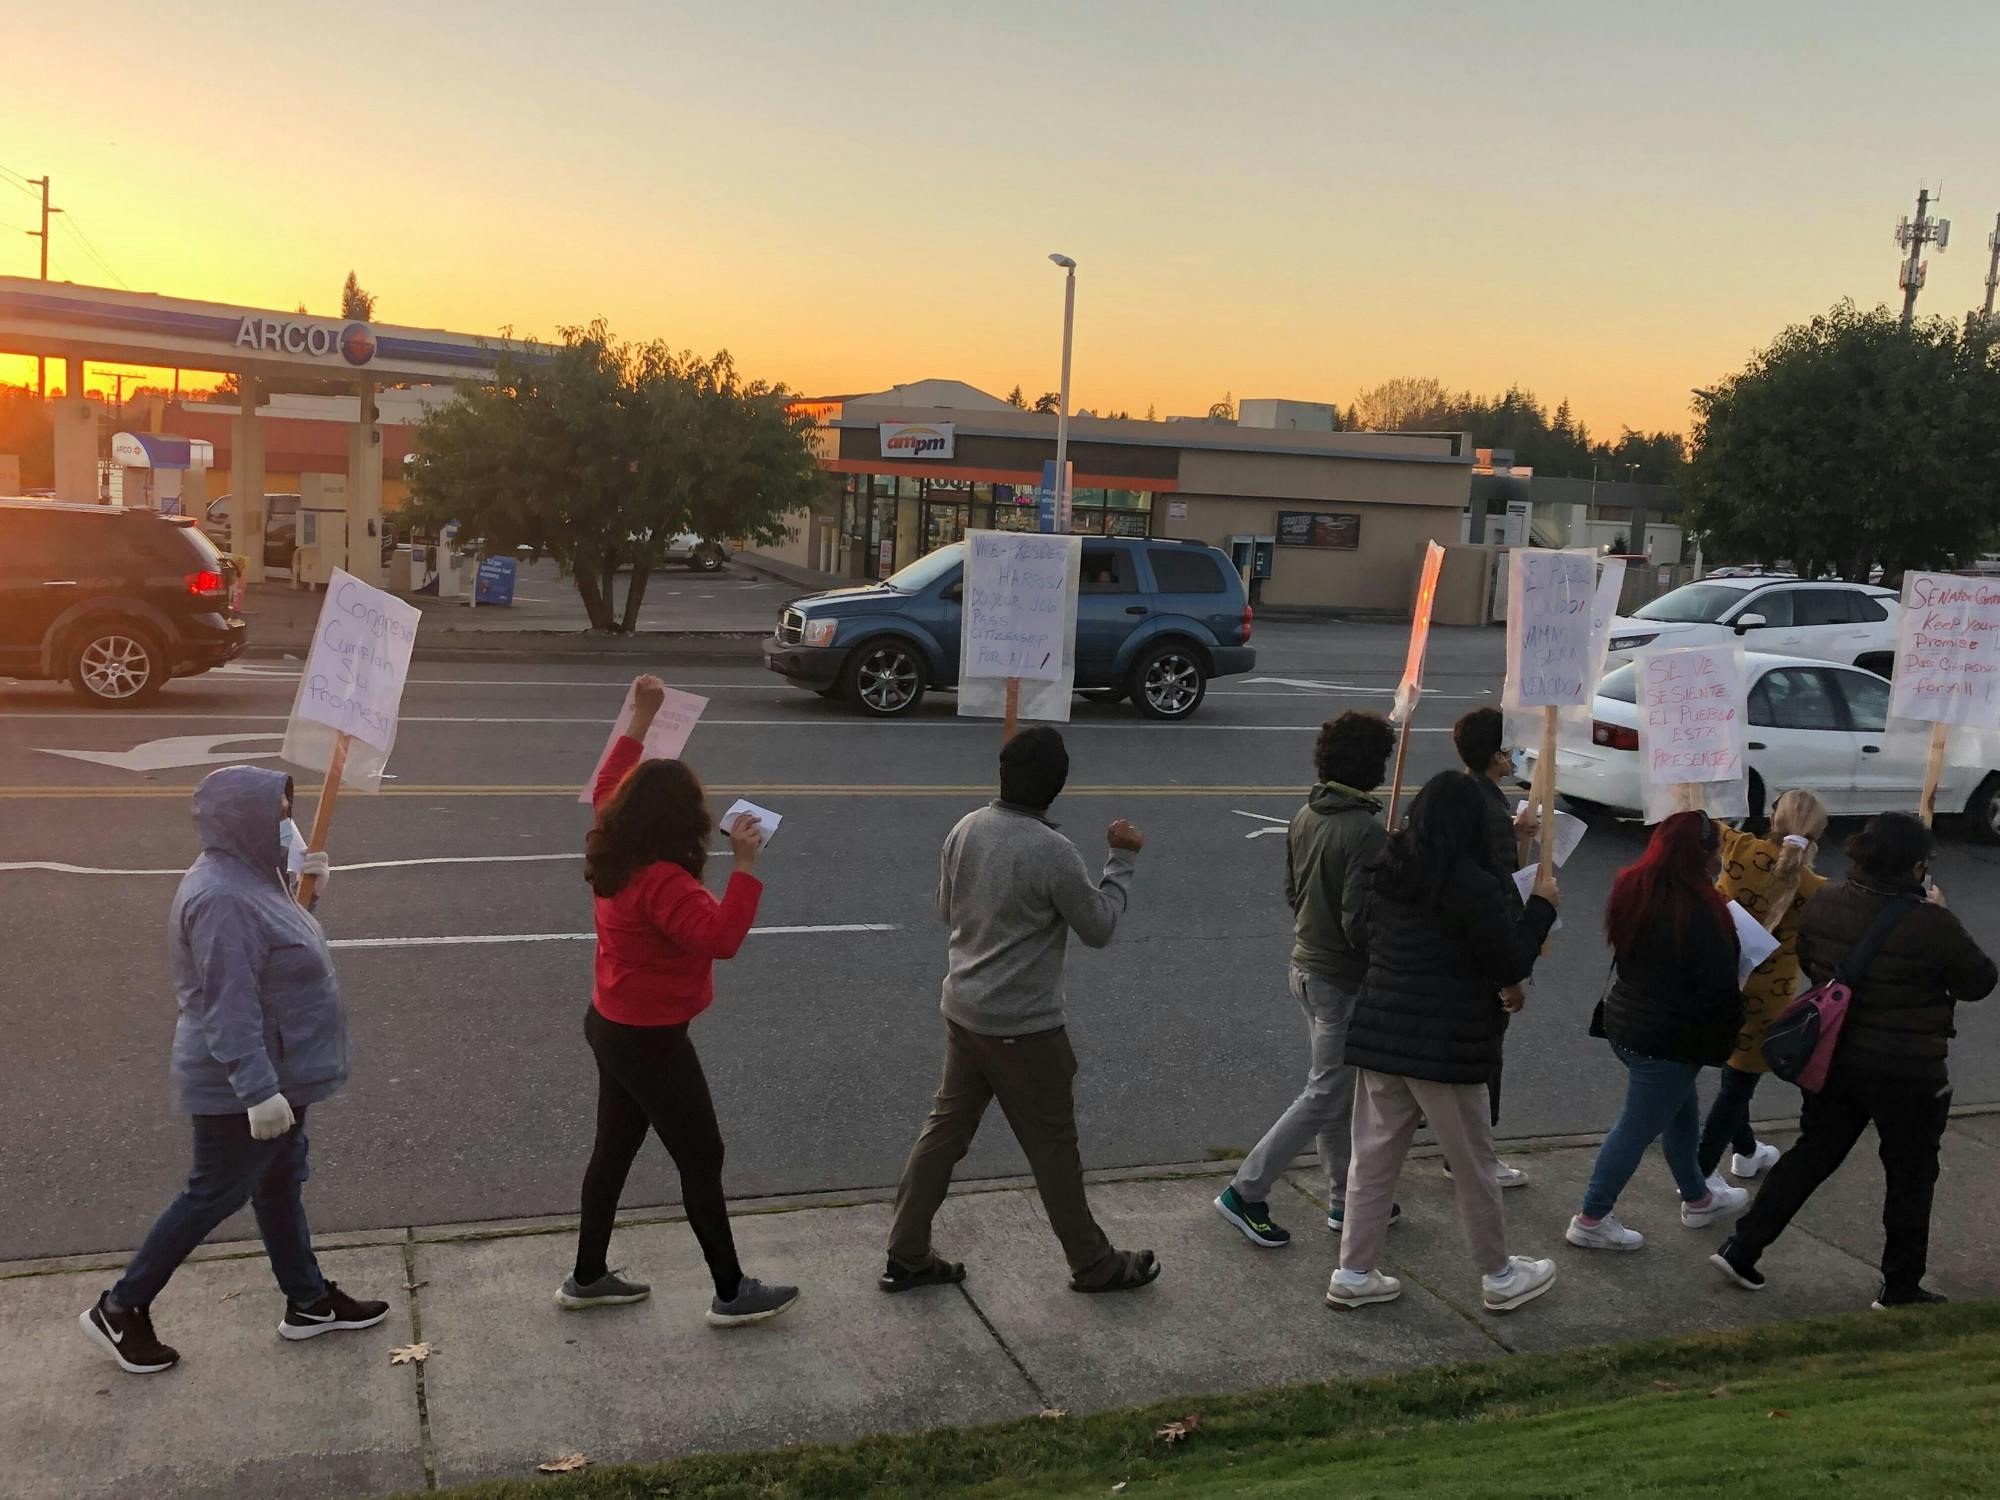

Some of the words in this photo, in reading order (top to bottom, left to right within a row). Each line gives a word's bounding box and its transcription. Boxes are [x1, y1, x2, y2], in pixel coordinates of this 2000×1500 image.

[235, 316, 330, 356] ARCO
[887, 436, 945, 455] ampm
[336, 582, 413, 642] Congreso
[1649, 659, 1682, 684] SE
[310, 674, 389, 732] Promesa
[1647, 687, 1666, 706] SE
[1649, 709, 1670, 725] EL
[1680, 705, 1735, 724] PUEBLO
[1672, 726, 1718, 743] ESTA
